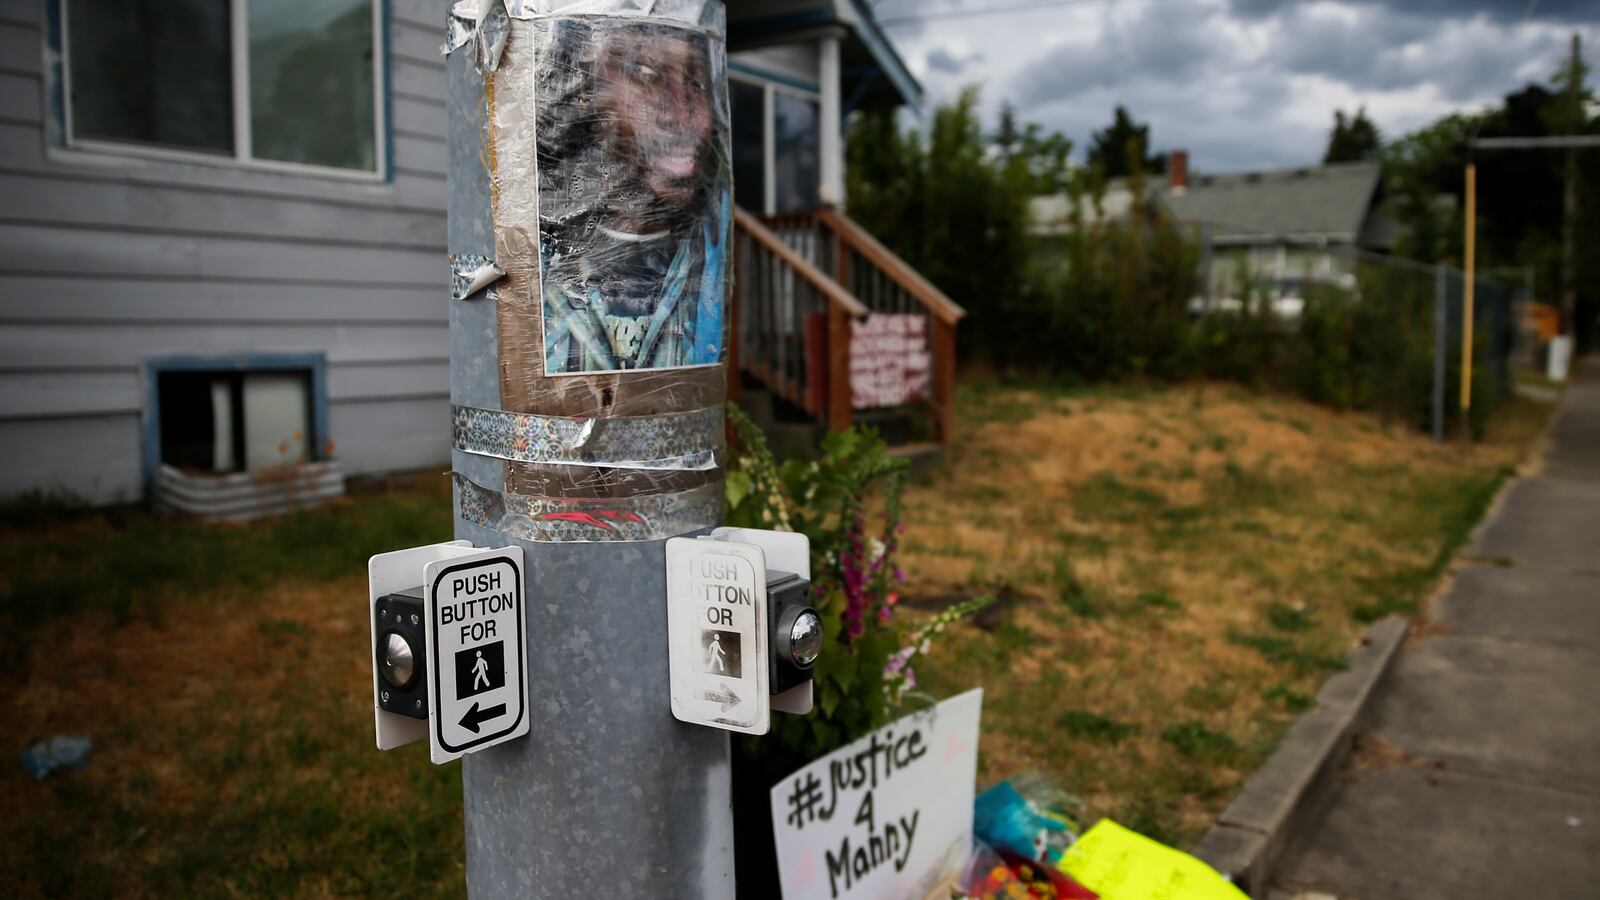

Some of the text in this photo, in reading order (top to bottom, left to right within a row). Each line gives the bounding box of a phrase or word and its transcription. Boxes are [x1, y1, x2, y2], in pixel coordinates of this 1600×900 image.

[453, 571, 501, 598] PUSH
[441, 592, 513, 626] BUTTON
[697, 604, 733, 626] OR
[461, 619, 497, 645] FOR
[855, 790, 874, 833] 4
[825, 809, 919, 899] Manny
